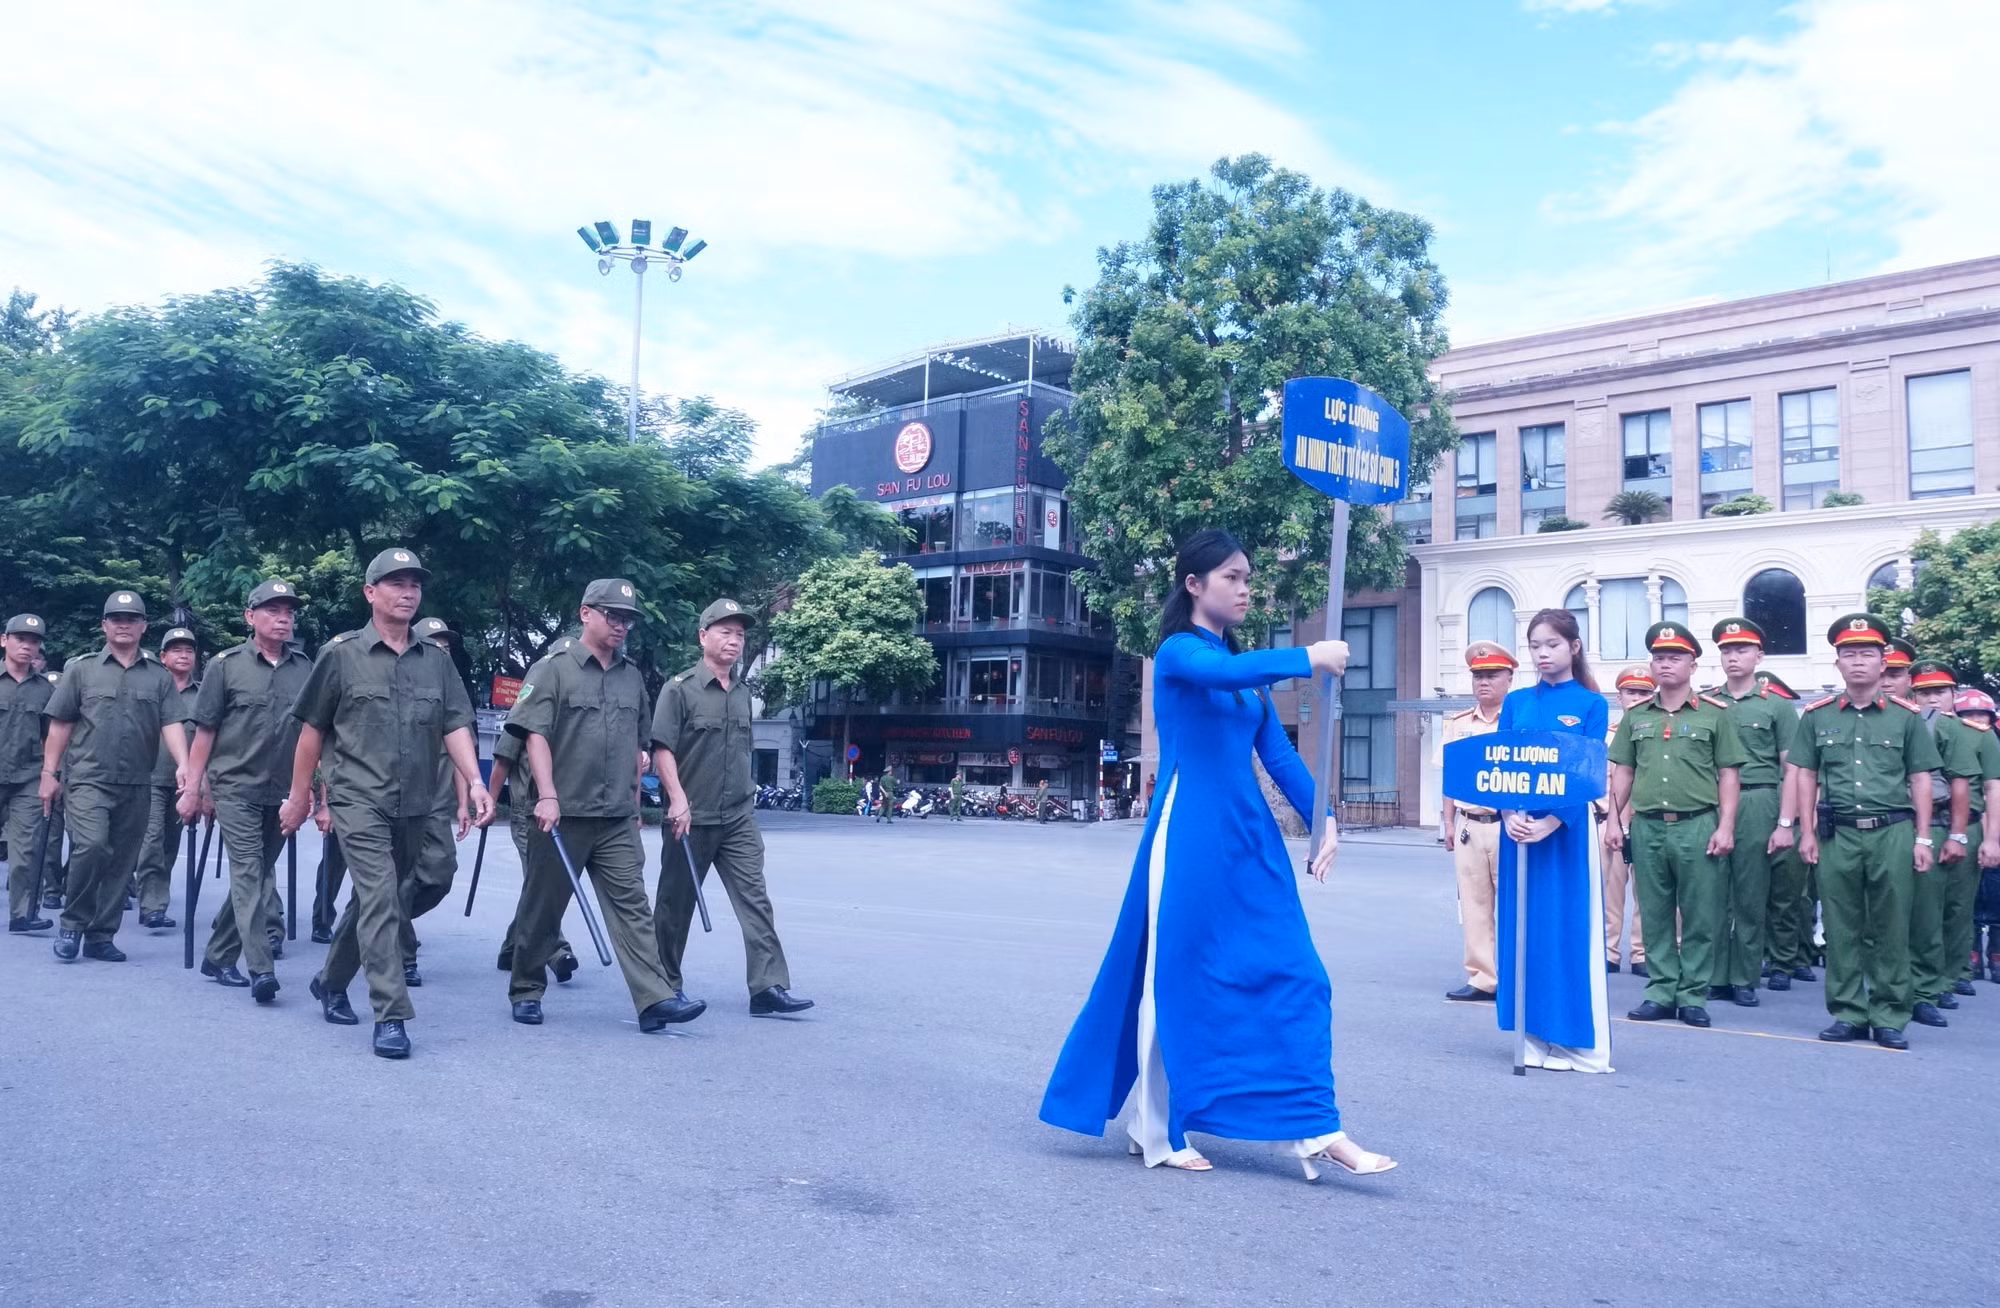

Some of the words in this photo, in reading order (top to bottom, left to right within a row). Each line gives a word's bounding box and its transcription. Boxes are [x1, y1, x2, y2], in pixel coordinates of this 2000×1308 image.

[1324, 397, 1346, 425] LỰC
[1348, 403, 1379, 433] LƯỢNG
[1295, 434, 1307, 468] AN
[1307, 437, 1327, 472] NINH
[1327, 437, 1346, 483] TRẬT
[1394, 459, 1400, 489] 3
[877, 481, 901, 497] SAN
[906, 478, 922, 492] FU
[927, 473, 951, 489] LOU
[1485, 745, 1511, 765] LỰC
[1513, 745, 1559, 766] LƯỢNG
[1476, 767, 1530, 794] CÔNG
[1535, 772, 1566, 795] AN
